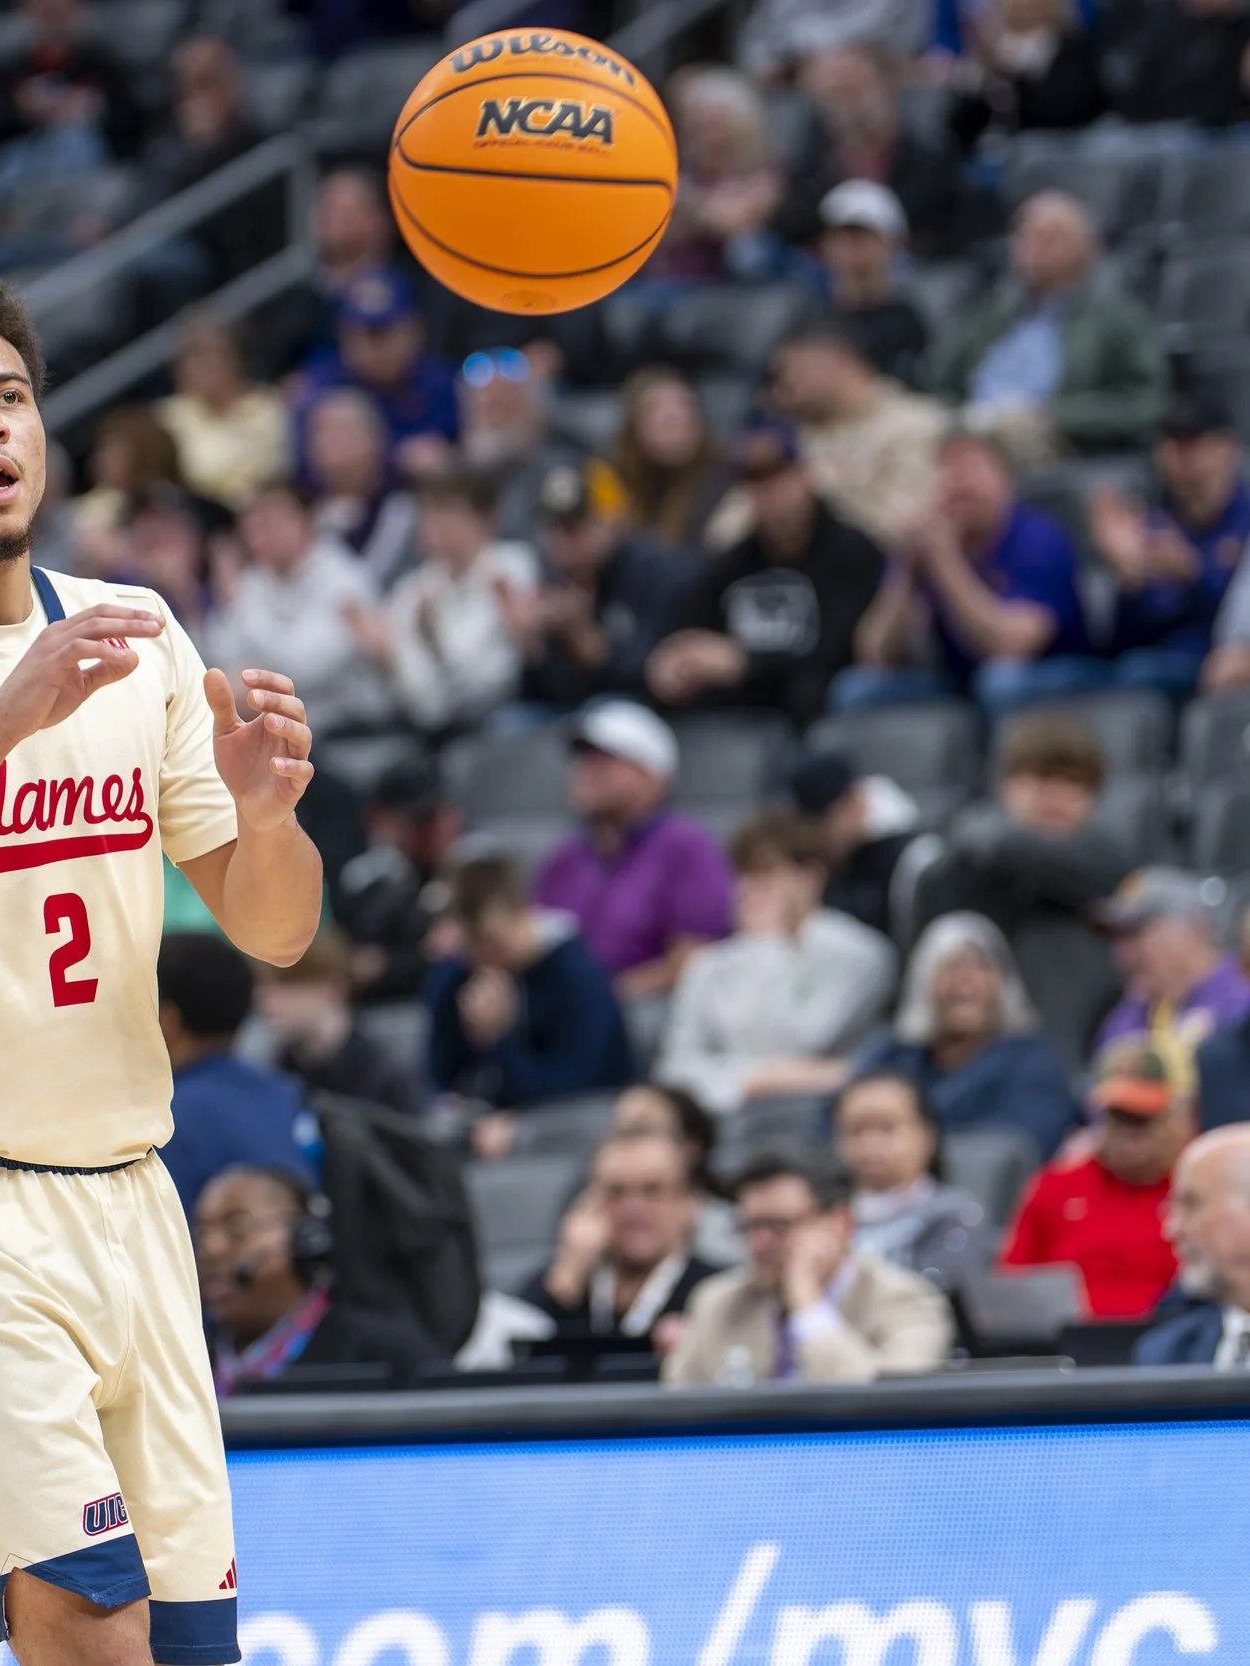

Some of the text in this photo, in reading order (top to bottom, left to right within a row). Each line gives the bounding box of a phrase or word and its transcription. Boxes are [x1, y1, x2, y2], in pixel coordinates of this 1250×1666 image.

[449, 34, 636, 87] Wilson
[476, 97, 613, 145] NCAA
[43, 893, 98, 1007] 2
[83, 1492, 129, 1536] UIC
